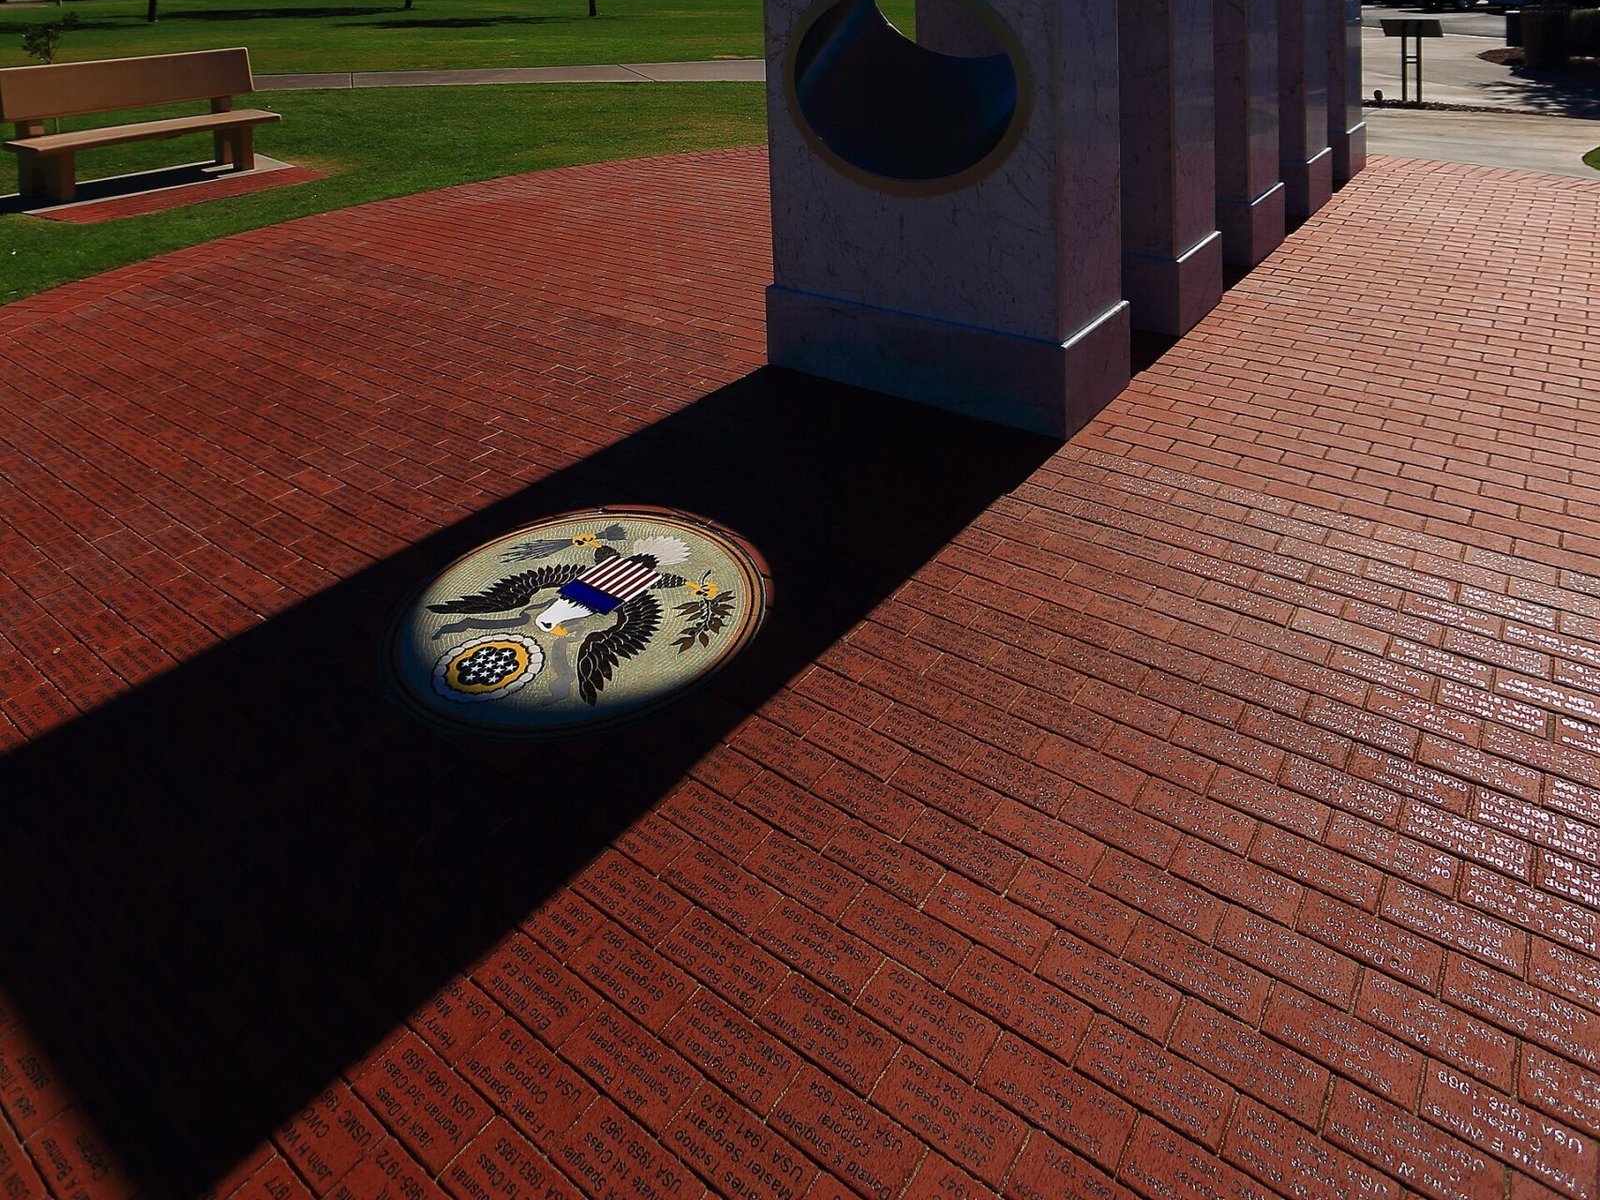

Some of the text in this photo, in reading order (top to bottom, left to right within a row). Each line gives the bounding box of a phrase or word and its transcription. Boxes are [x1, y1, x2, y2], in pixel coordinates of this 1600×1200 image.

[1496, 713, 1537, 732] James
[704, 829, 743, 855] Harvey
[735, 815, 764, 834] USN
[605, 878, 633, 898] Tech
[628, 893, 670, 924] Aviation
[699, 871, 740, 900] Captain
[600, 929, 687, 994] USA 1952-1962
[663, 939, 698, 966] Smith
[675, 926, 769, 993] Master Sergeant
[689, 916, 777, 977] USA 1941-1950
[790, 928, 841, 965] Sergeant
[925, 934, 958, 958] USA
[499, 959, 572, 1018] Specialist E4
[507, 942, 591, 1008] USA 1987-1990
[584, 962, 652, 1015] Sid Shearer
[595, 945, 667, 1001] Sergeant E5
[721, 979, 758, 1008] David
[465, 998, 493, 1022] USA
[487, 975, 554, 1030] Eric Nichols
[905, 998, 969, 1045] Sergeant
[953, 1009, 987, 1035] USA
[684, 1013, 776, 1084] Lance Corporal
[692, 995, 795, 1074] USMC 2004-2007
[761, 1007, 868, 1087] Thomas E Winter
[799, 1009, 852, 1051] Captain
[853, 1024, 885, 1051] USA
[917, 1028, 974, 1070] Thomas
[498, 1055, 553, 1105] Corporal
[551, 1073, 585, 1104] USA
[584, 1026, 677, 1103] Technical Sergeant
[659, 1061, 693, 1090] USAF
[371, 1086, 435, 1149] Jack H Dees
[378, 1058, 467, 1144] Yeoman 3rd Class
[447, 1092, 477, 1121] USN
[462, 1054, 559, 1143] J Frank Spangler
[900, 1077, 962, 1126] Sergeant
[681, 1107, 795, 1200] Master Sergeant
[698, 1093, 805, 1181] USA 1941-1973
[815, 1108, 873, 1157] Corporal
[872, 1126, 904, 1154] USA
[556, 1139, 612, 1192] Spangler
[654, 1162, 686, 1193] USA
